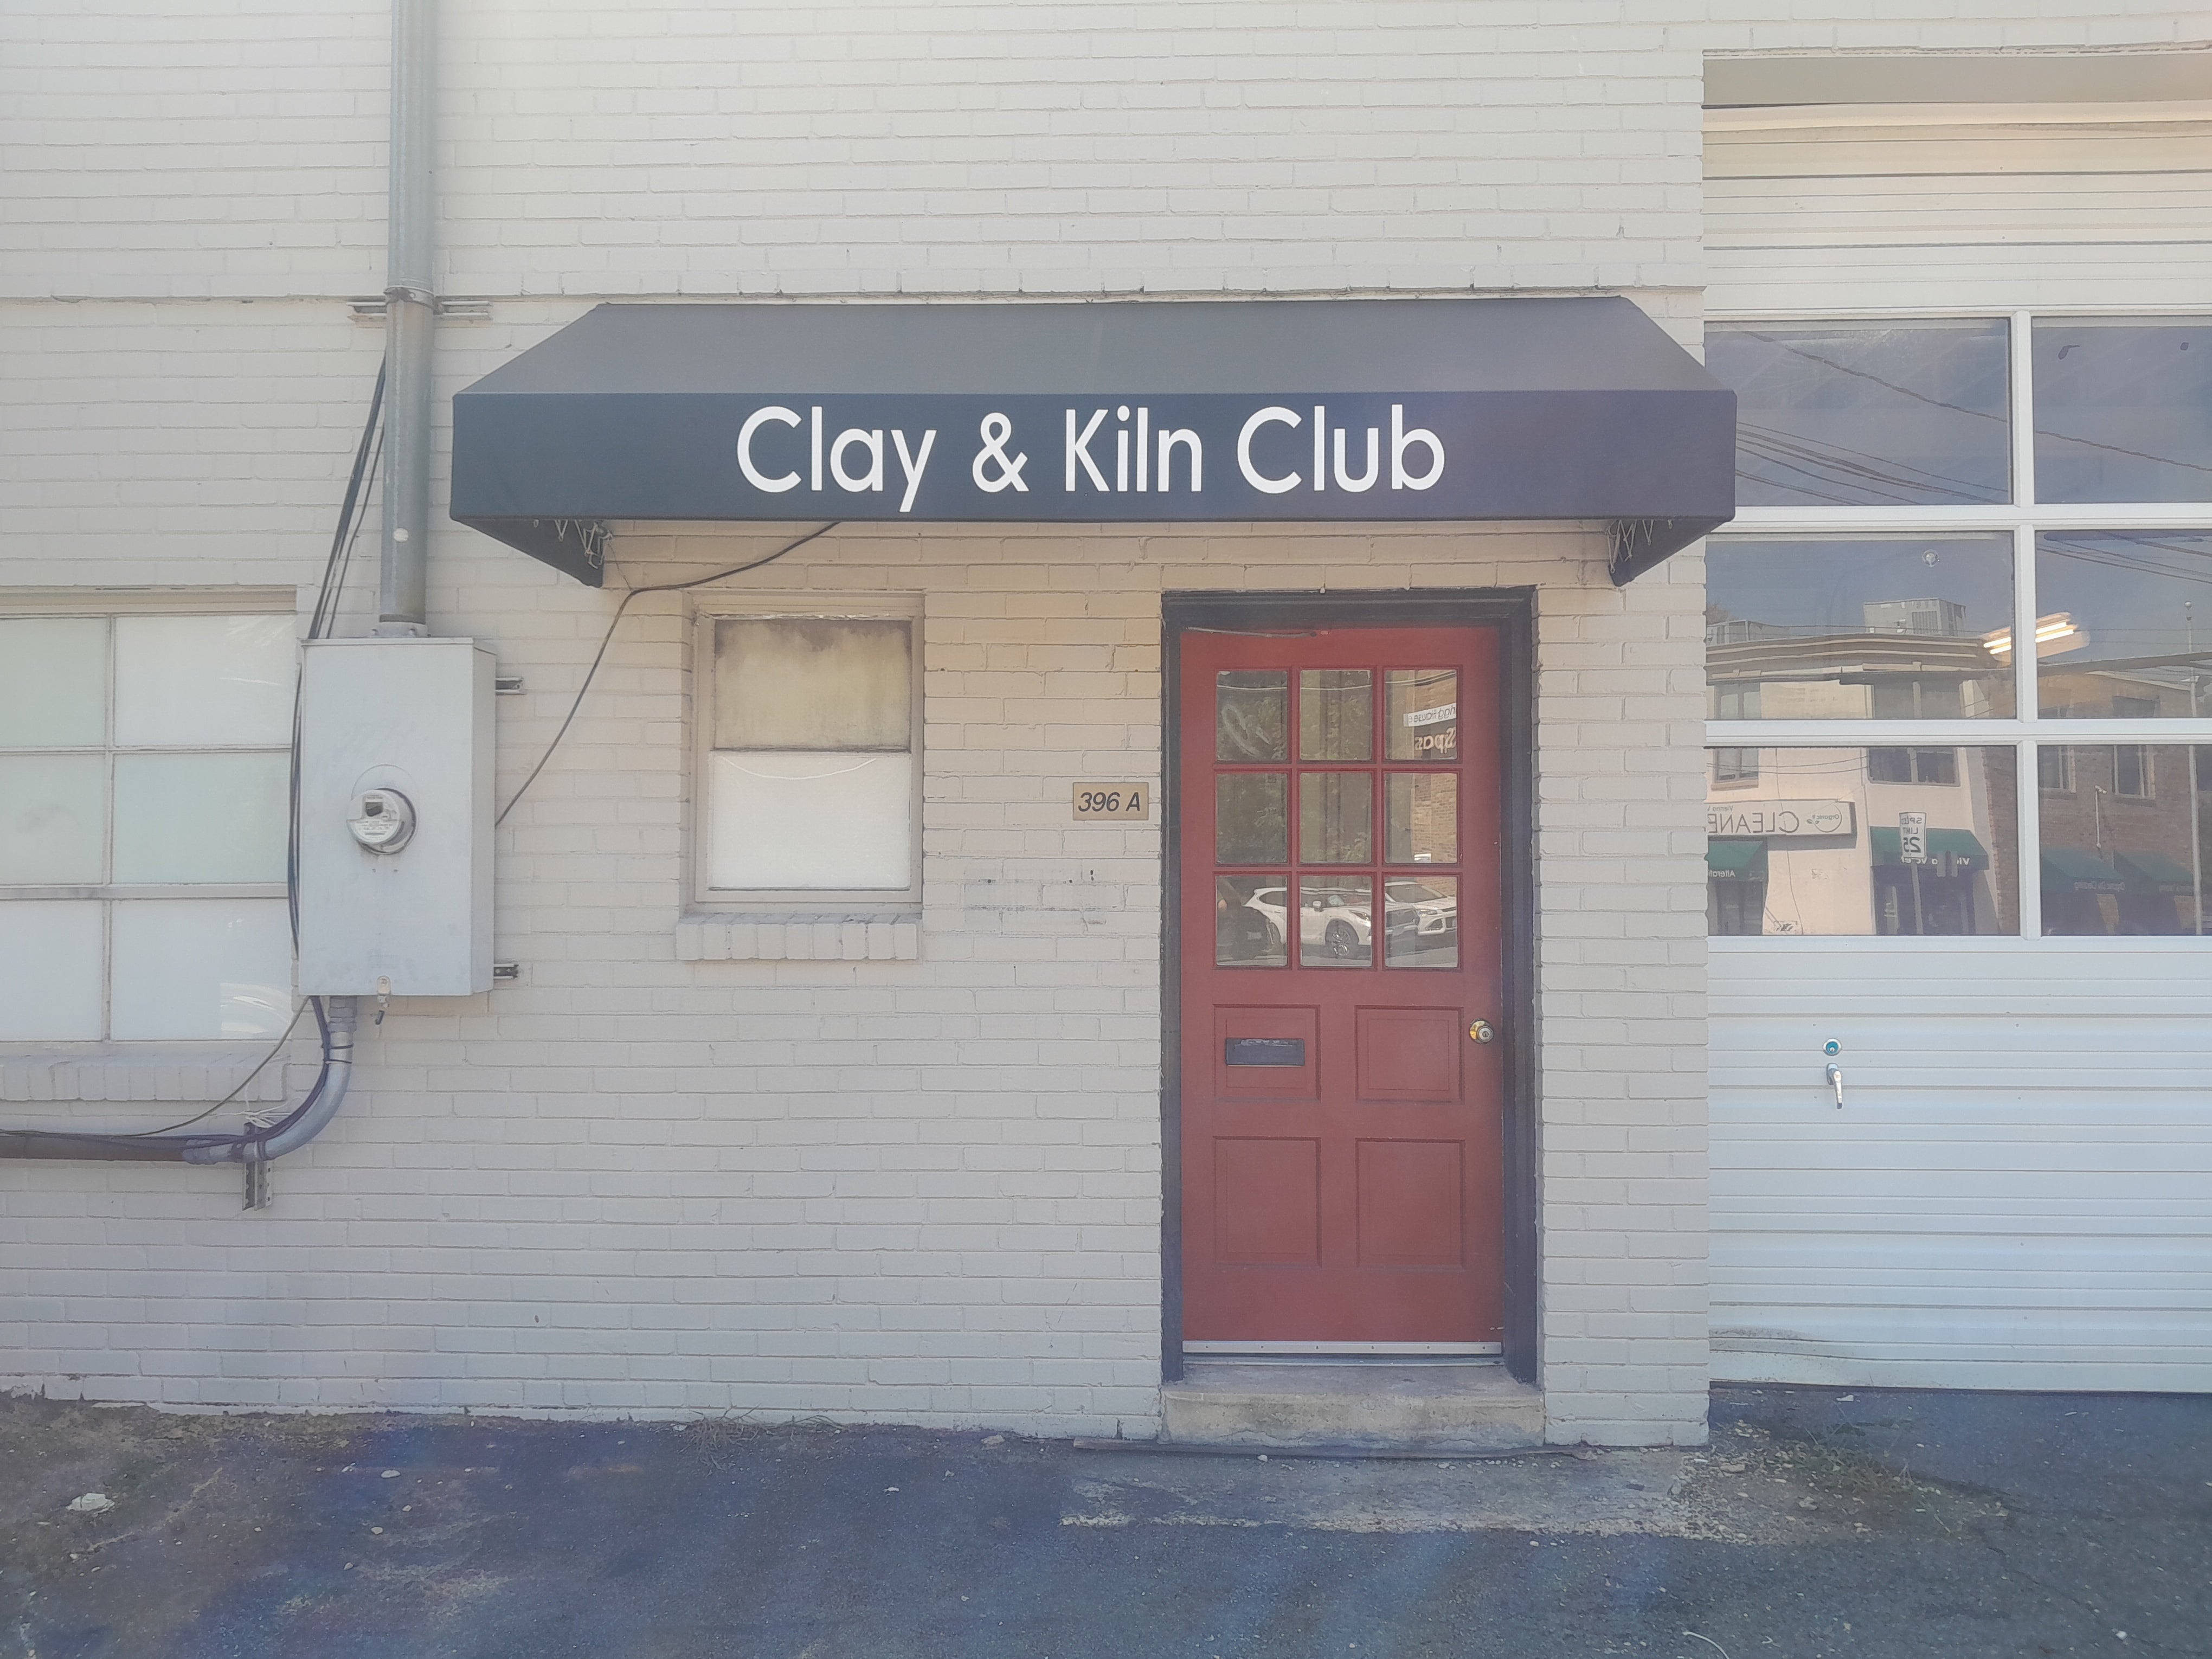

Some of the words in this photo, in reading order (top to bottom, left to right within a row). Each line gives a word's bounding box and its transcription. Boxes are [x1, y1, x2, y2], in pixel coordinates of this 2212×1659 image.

[737, 406, 937, 513] Clay
[972, 412, 1030, 493] &
[1065, 405, 1203, 492] Kiln
[1237, 404, 1445, 494] Club
[1078, 792, 1121, 812] 396
[1125, 792, 1141, 812] A
